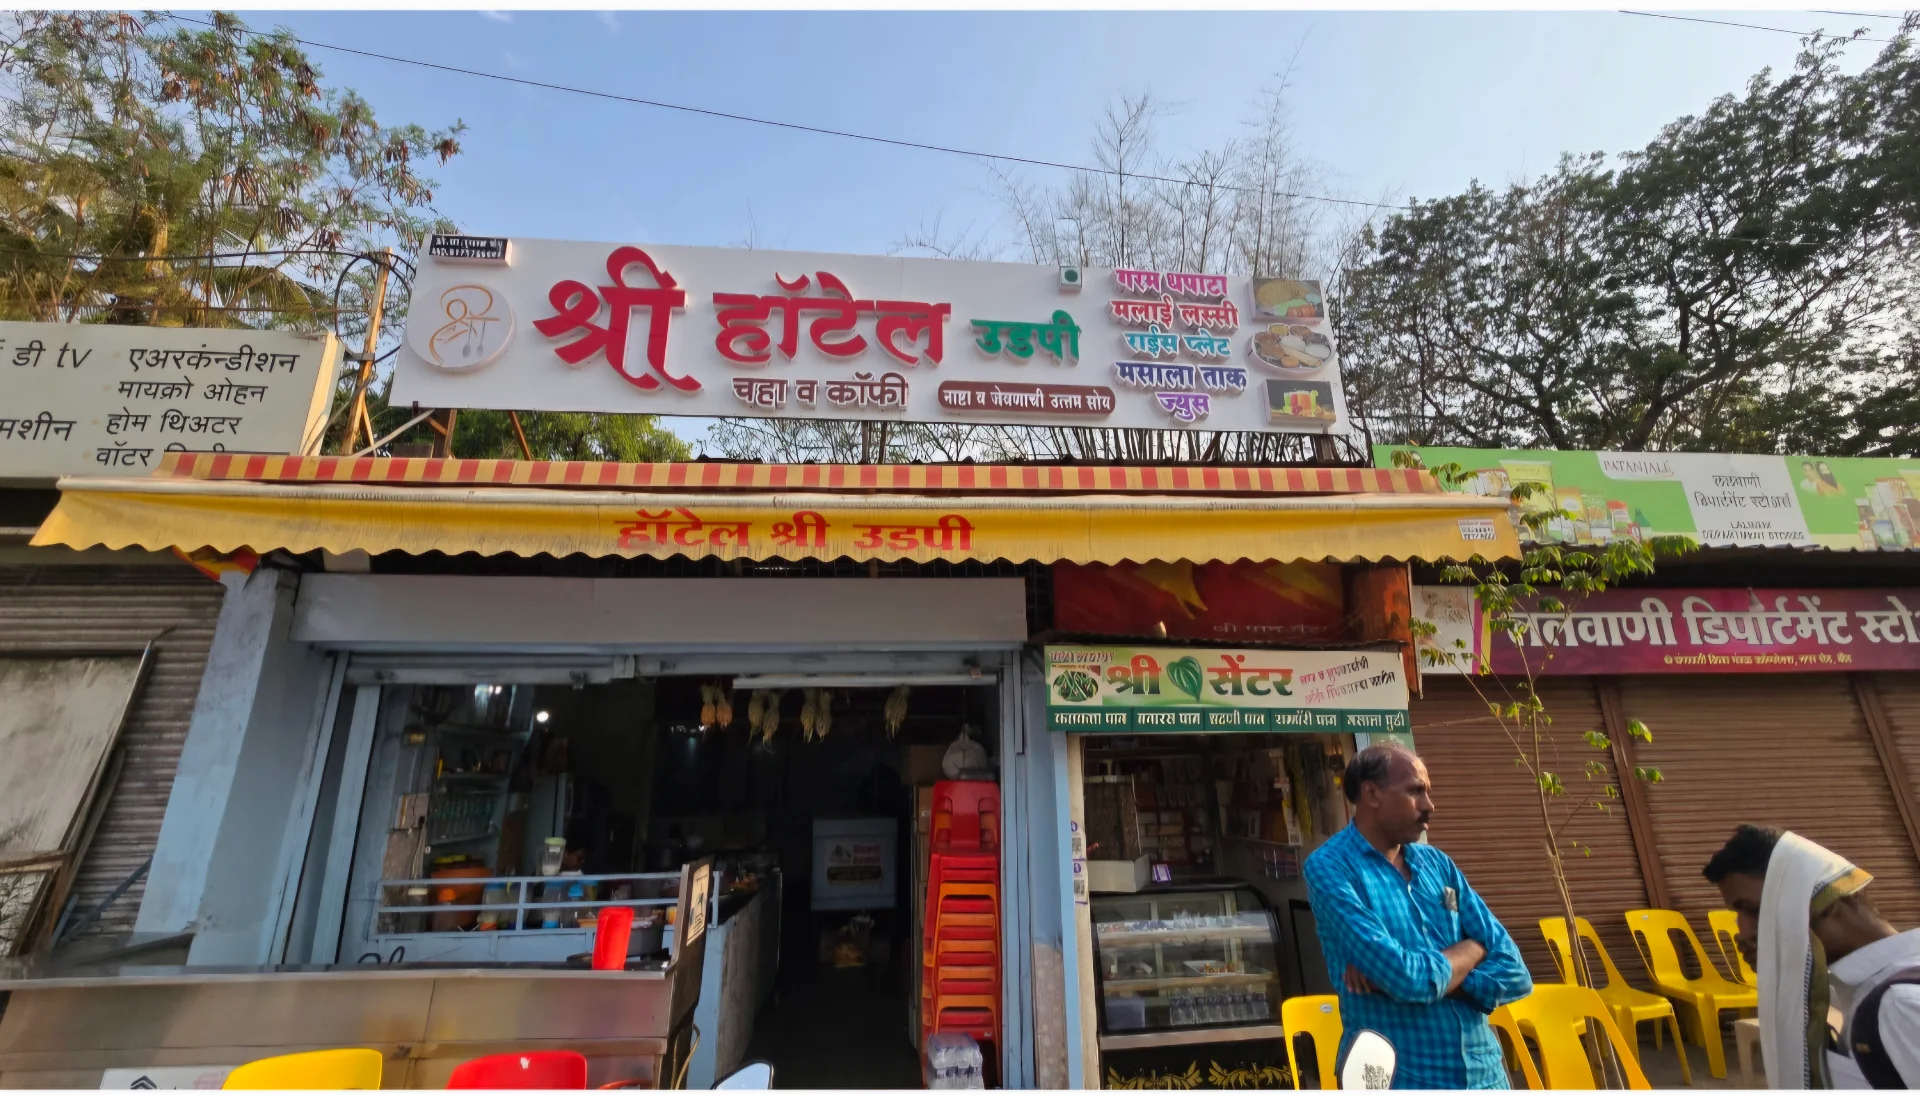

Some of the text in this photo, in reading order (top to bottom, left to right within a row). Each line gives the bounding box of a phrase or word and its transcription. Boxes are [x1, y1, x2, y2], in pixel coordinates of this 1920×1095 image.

[1114, 269, 1162, 293] गरम
[533, 246, 1082, 392] श्री हॉटेल उडपी
[1110, 294, 1239, 329] मलाई लस्सी
[12, 340, 46, 367] डी
[57, 342, 92, 368] tv
[1123, 325, 1232, 357] राईस प्लेट
[203, 377, 269, 405] ओहन
[733, 371, 909, 410] चहा व कॉफी
[1115, 362, 1247, 391] मसाला ताक
[976, 391, 986, 406] व
[990, 385, 1044, 408] जेवणाची
[1049, 394, 1081, 409] उत्तम
[1085, 389, 1111, 410] सोय
[1155, 393, 1210, 421] ज्युस
[0, 411, 77, 441] मशीन
[106, 406, 242, 434] होम थिअटर
[97, 441, 154, 466] वॉटर
[614, 507, 976, 551] हॉटेल श्री उडपी
[1681, 596, 1853, 645] डिपार्टमेंट
[1106, 653, 1162, 695] श्री
[1207, 654, 1293, 696] सेंटर
